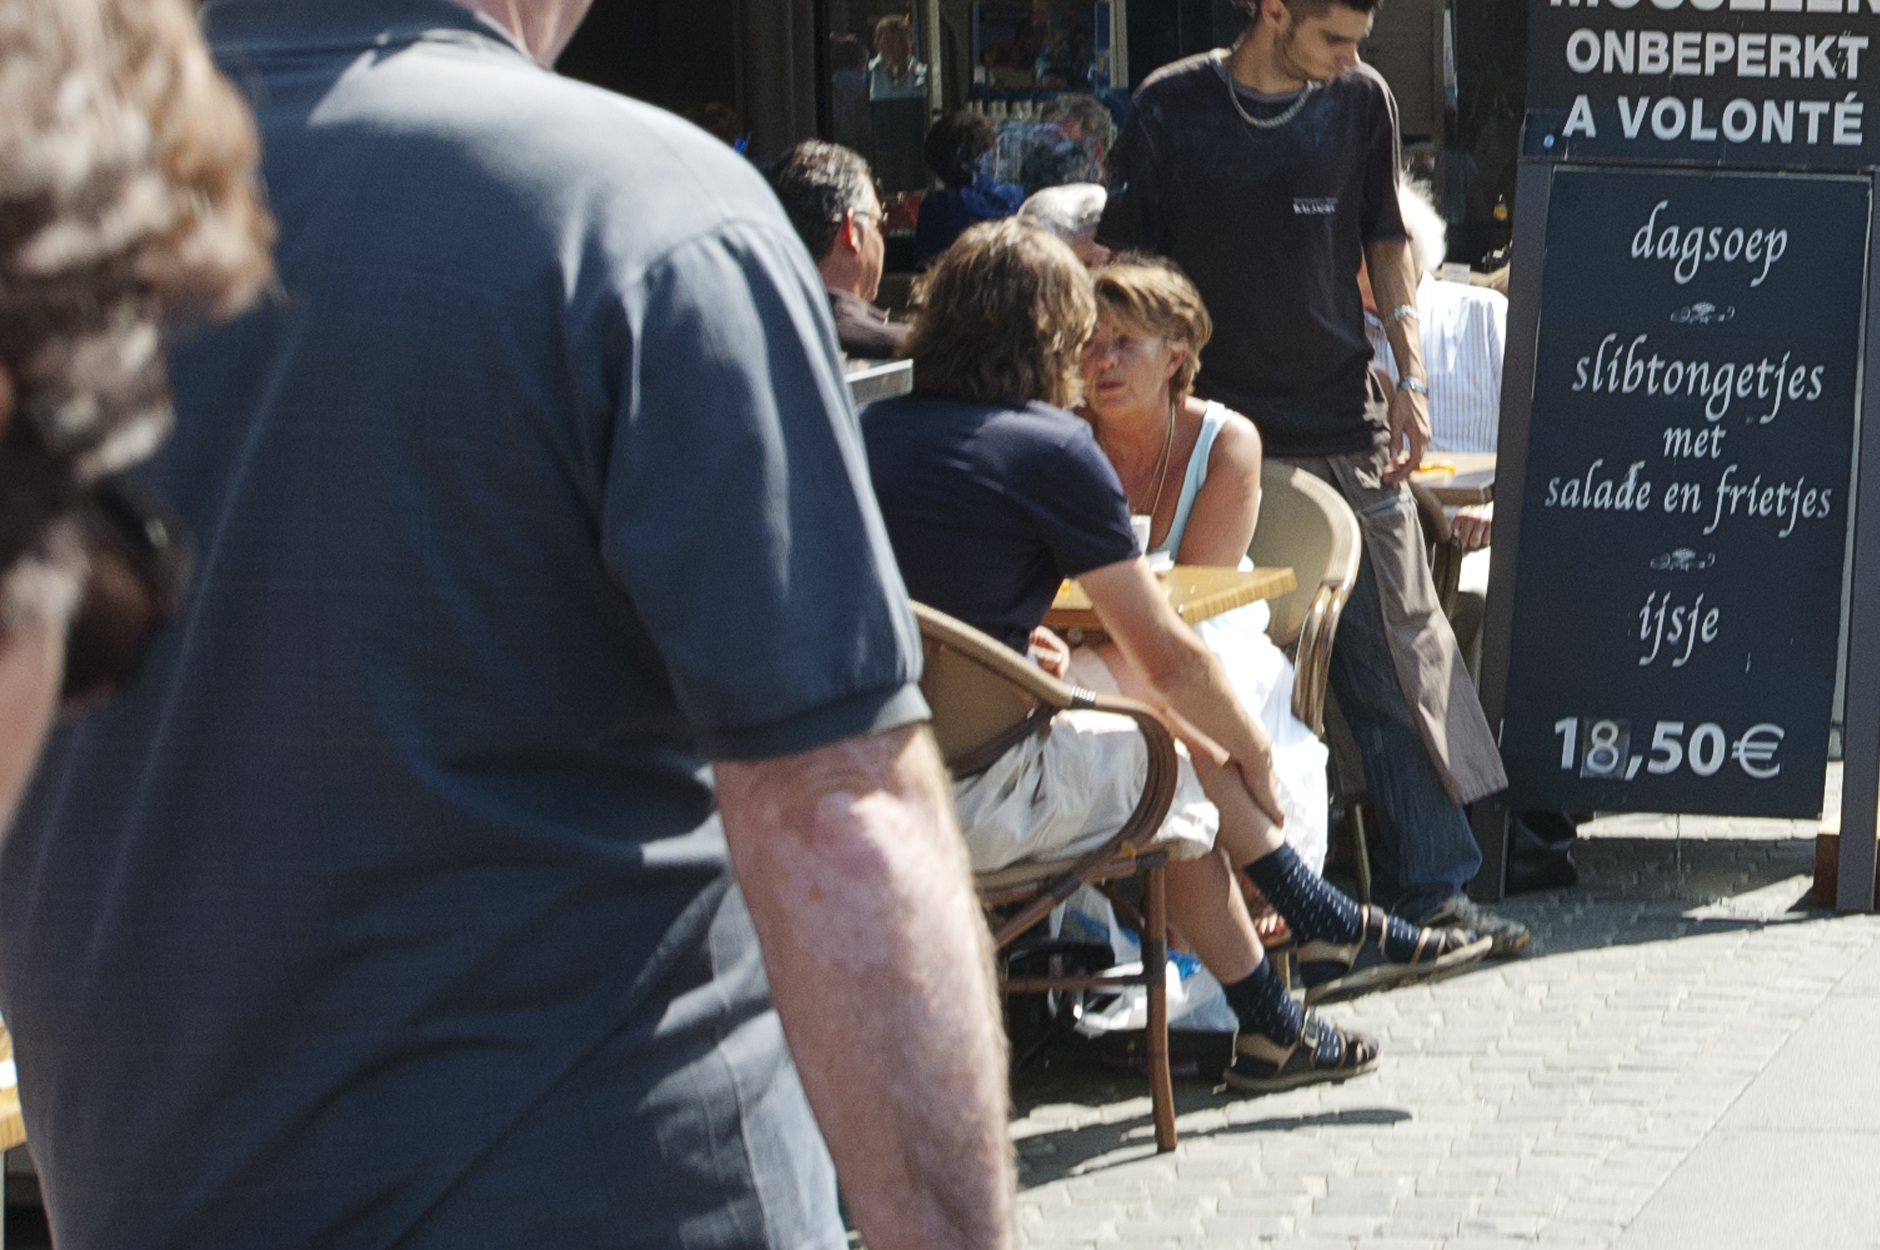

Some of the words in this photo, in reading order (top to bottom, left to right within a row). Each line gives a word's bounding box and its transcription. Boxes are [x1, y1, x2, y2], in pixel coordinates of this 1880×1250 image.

[1566, 27, 1869, 79] ONBEPERKT
[1562, 94, 1597, 139] A
[1616, 90, 1864, 146] VOLONTÉ
[1631, 200, 1788, 287] dagsoep
[1571, 333, 1825, 424] slibtongetjes
[1662, 424, 1727, 459] met
[1544, 459, 1652, 510] salade
[1663, 483, 1702, 513] en
[1703, 464, 1832, 538] frietjes
[1638, 591, 1720, 668] ijsje
